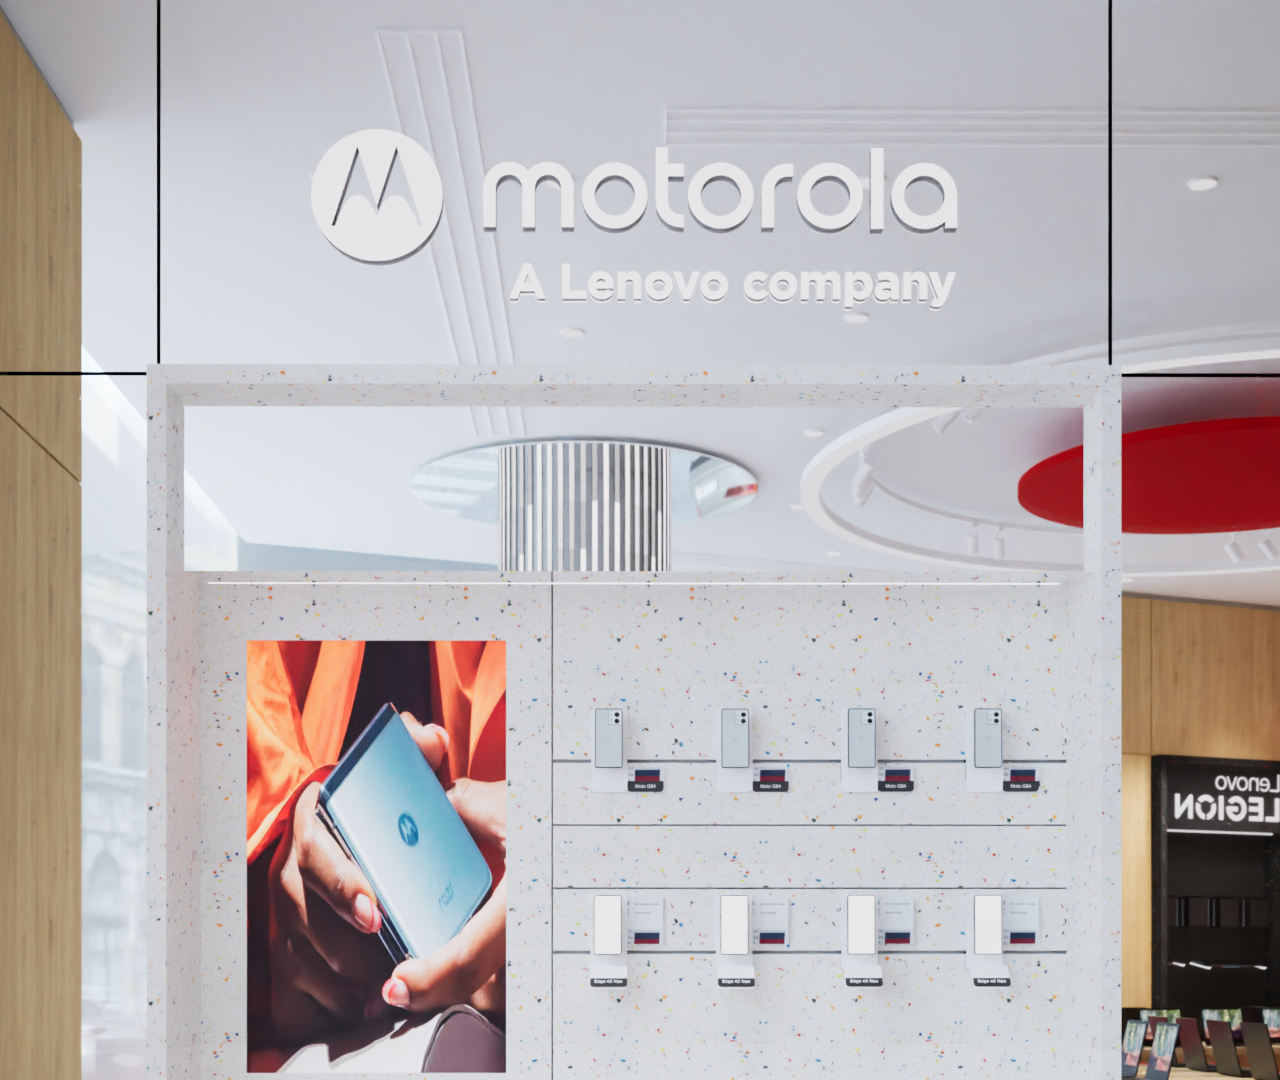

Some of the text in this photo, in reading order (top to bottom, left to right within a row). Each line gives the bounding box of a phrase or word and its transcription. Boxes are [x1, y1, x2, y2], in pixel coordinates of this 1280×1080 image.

[482, 146, 958, 233] motorola
[509, 262, 957, 312] A Lenovo company
